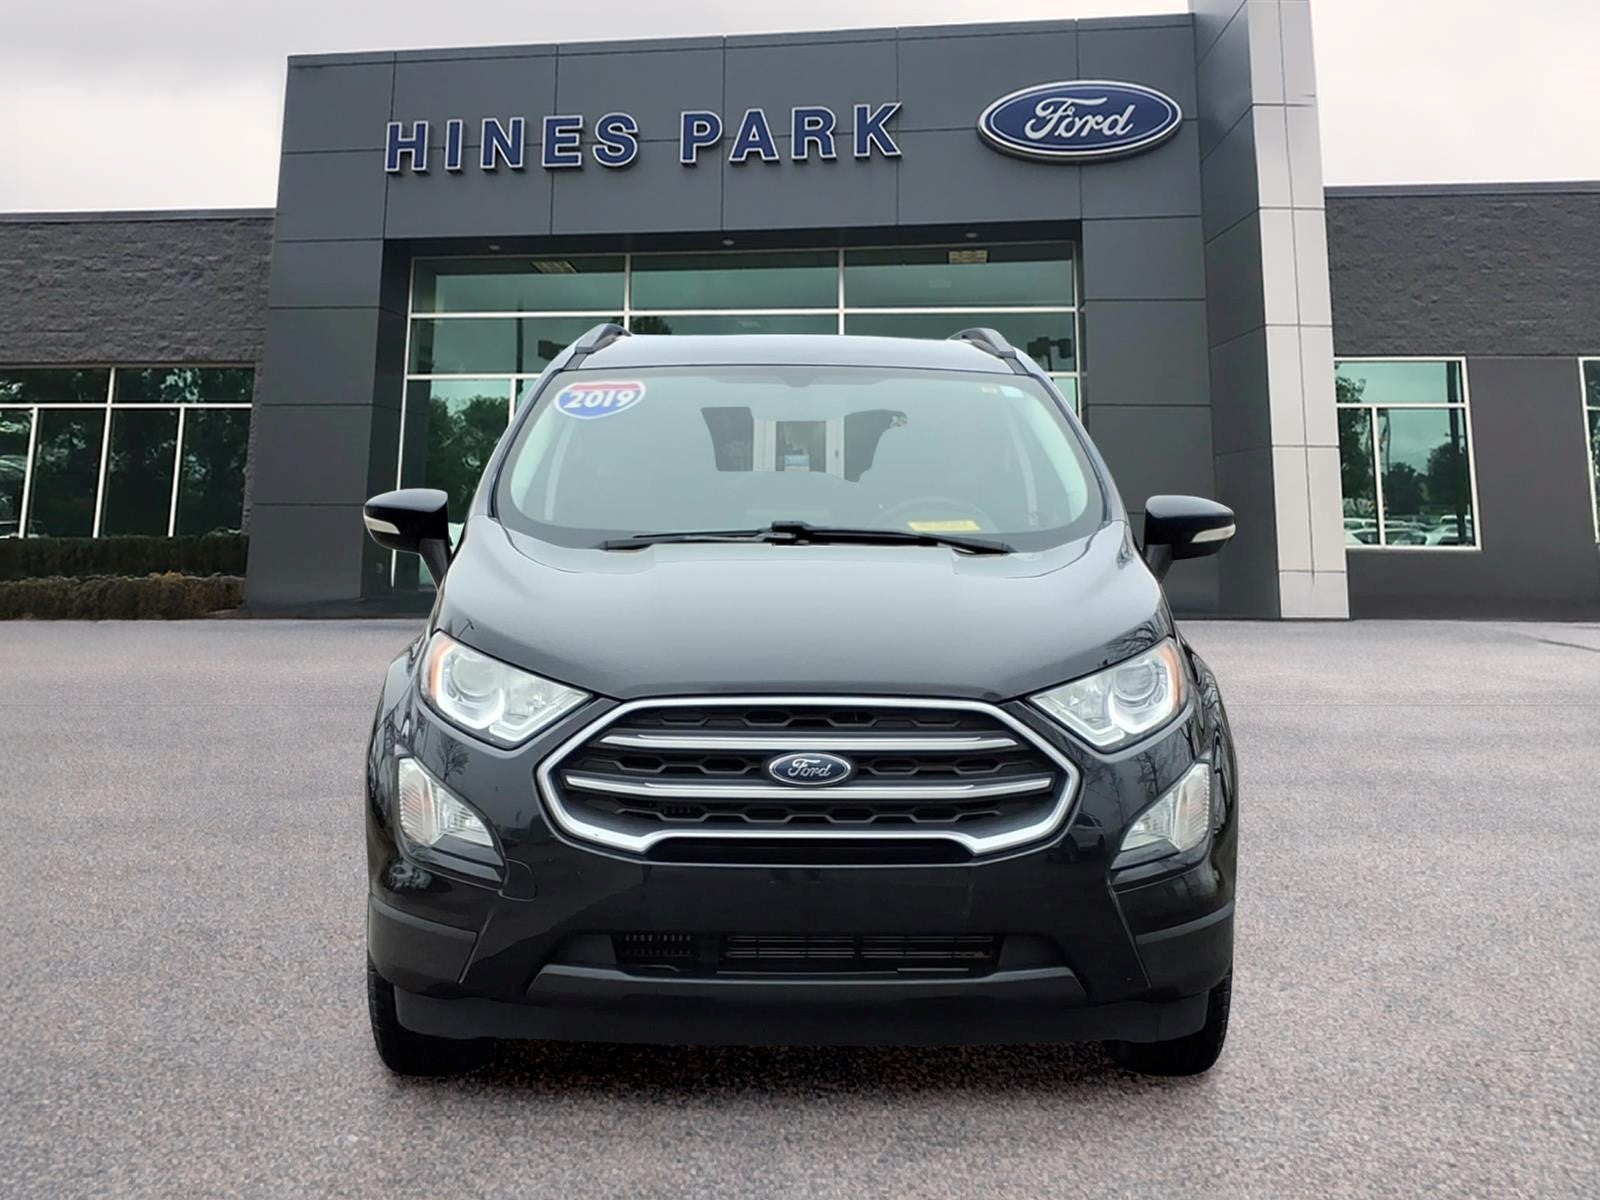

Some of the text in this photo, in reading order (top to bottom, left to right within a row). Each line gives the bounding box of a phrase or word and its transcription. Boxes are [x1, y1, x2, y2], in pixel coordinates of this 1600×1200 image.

[1024, 97, 1136, 139] Ford
[384, 102, 903, 172] HINES PARK
[563, 390, 636, 409] 2019
[788, 758, 832, 777] Ford
